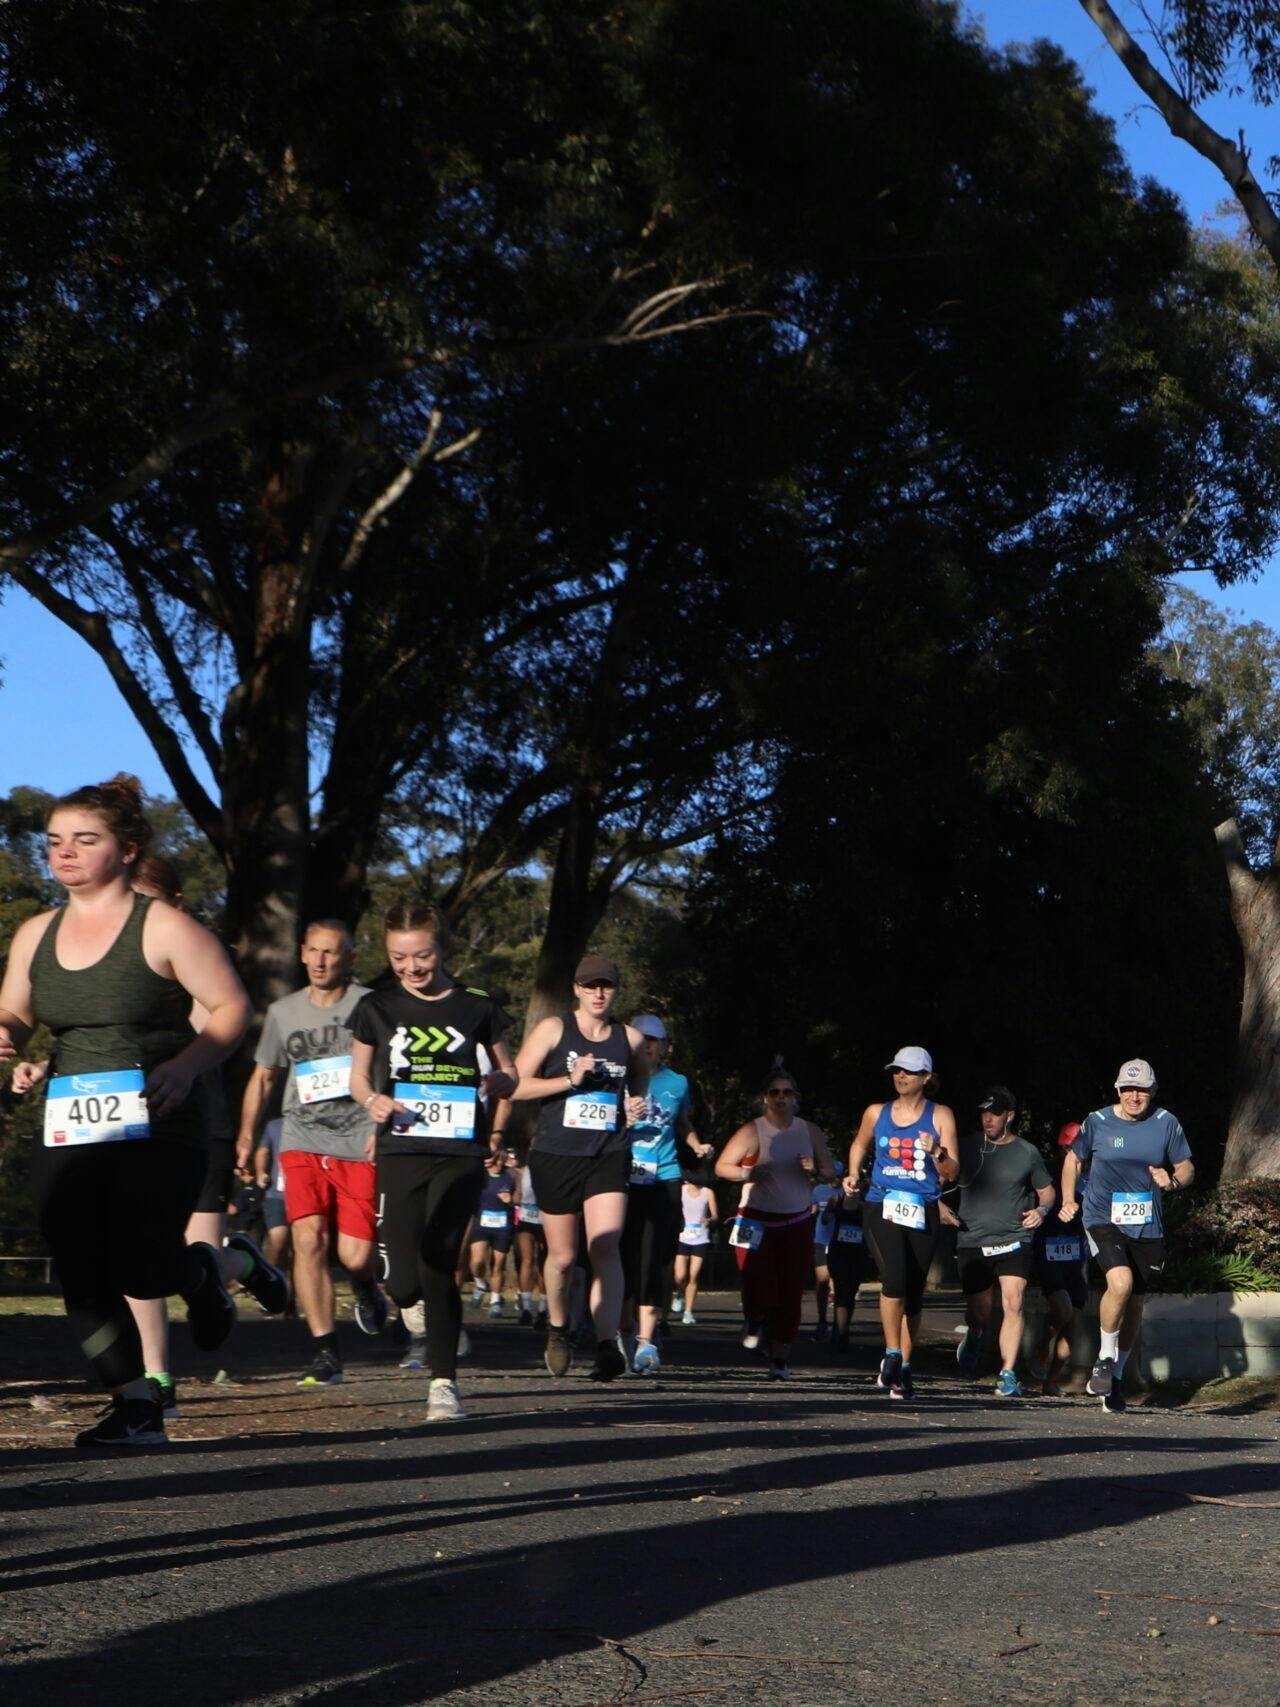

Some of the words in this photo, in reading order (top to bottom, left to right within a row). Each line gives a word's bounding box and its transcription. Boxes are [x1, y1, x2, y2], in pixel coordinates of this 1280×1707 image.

[410, 1056, 433, 1064] THE
[311, 1071, 340, 1090] 224
[410, 1073, 460, 1081] PROJECT
[69, 1096, 122, 1124] 402
[415, 1102, 452, 1123] 281
[579, 1103, 607, 1119] 226
[895, 1203, 918, 1218] 467
[1122, 1203, 1146, 1216] 228
[1054, 1245, 1072, 1255] 418
